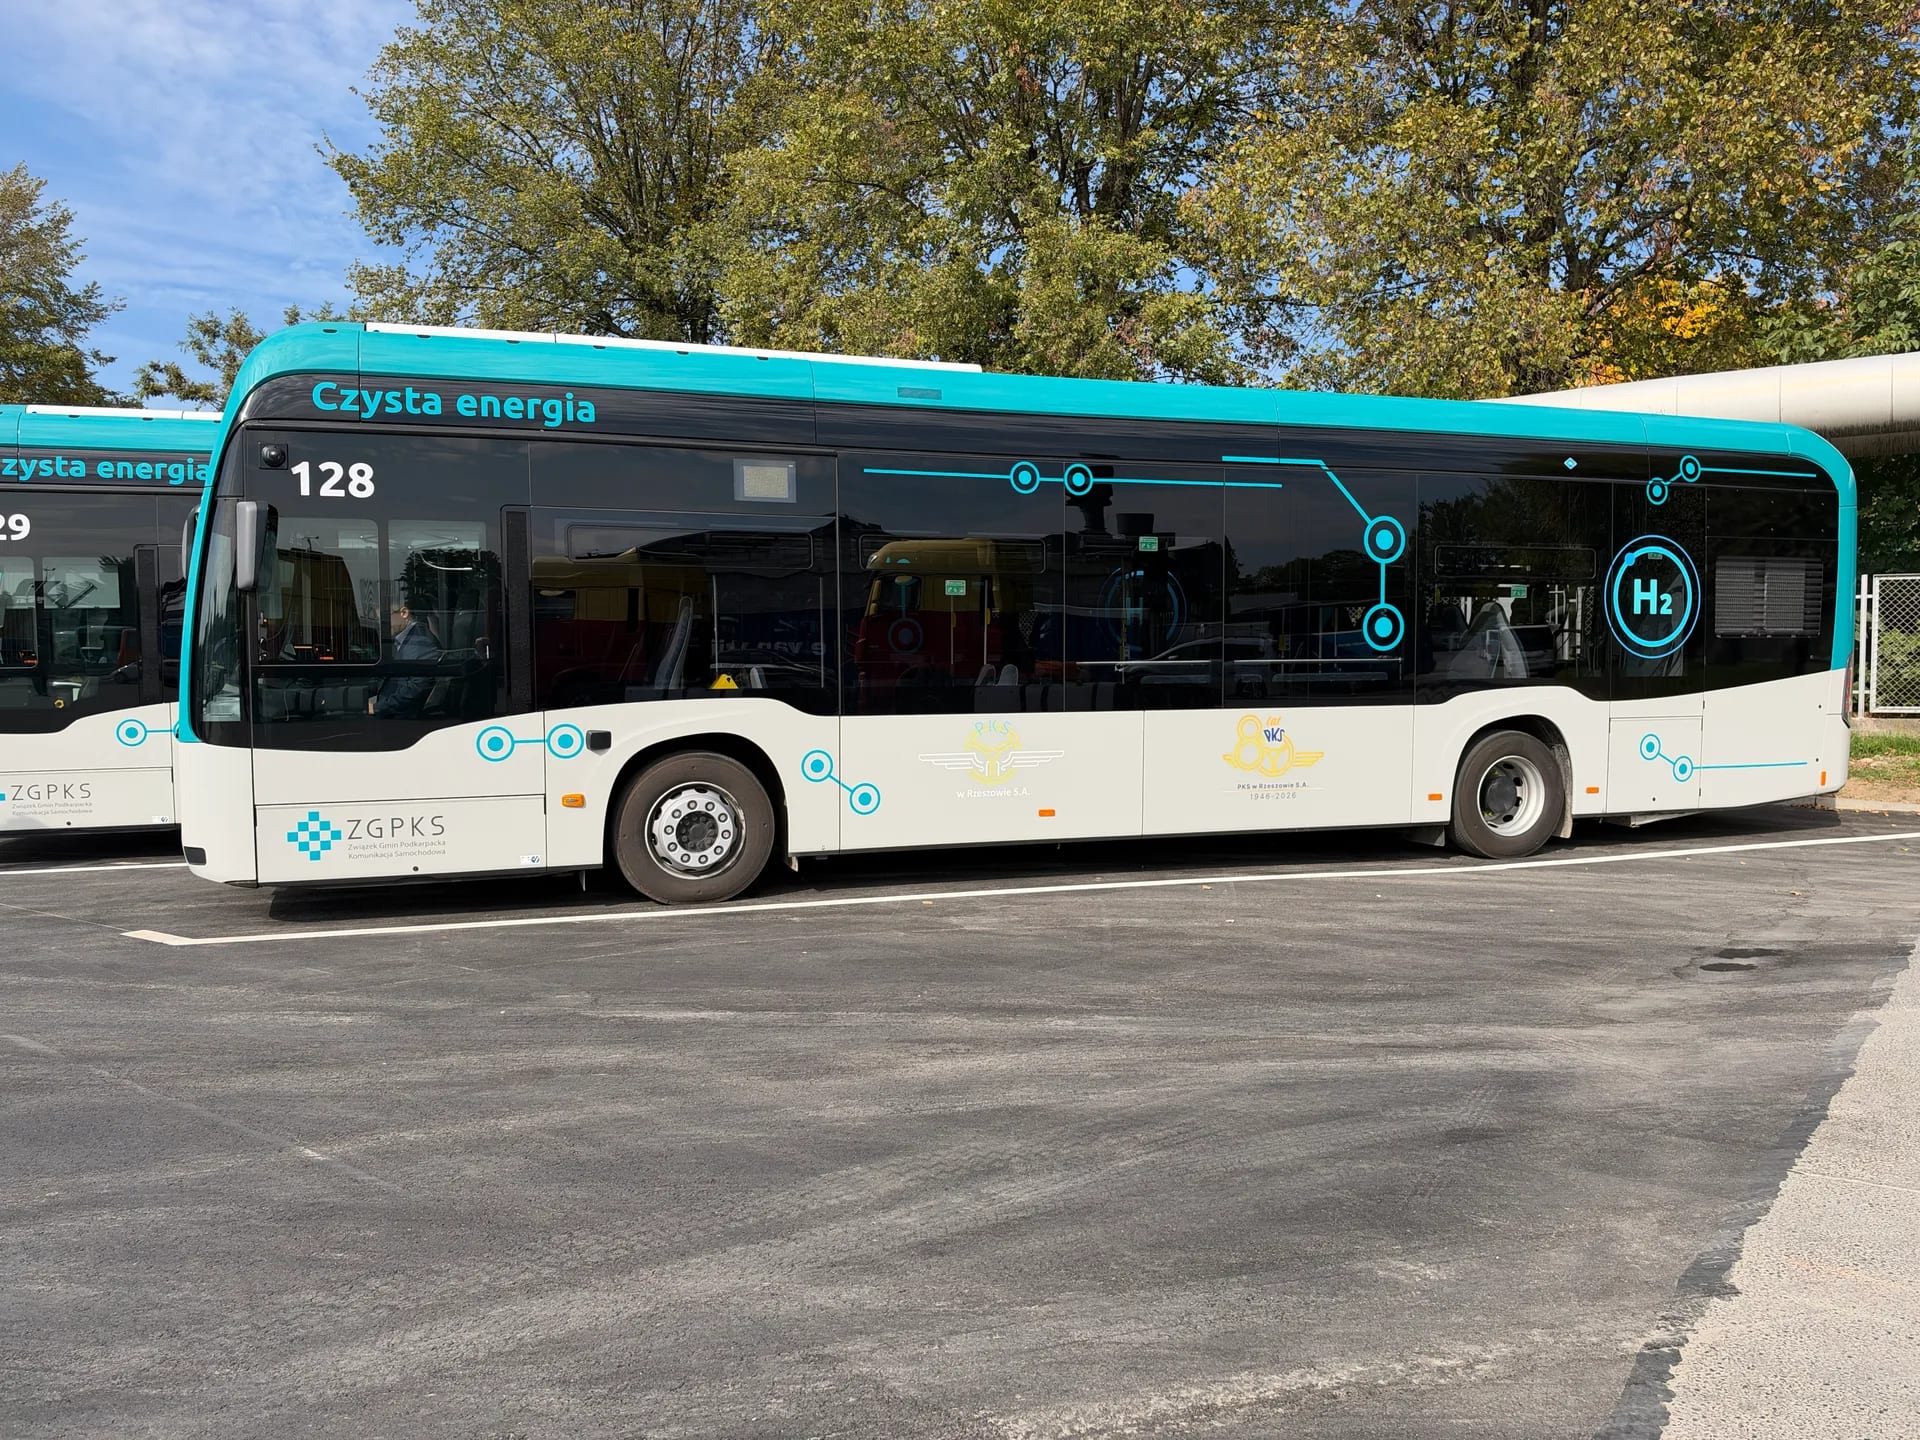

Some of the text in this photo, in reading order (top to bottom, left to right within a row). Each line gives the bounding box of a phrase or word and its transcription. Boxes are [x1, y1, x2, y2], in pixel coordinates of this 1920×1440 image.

[311, 381, 596, 427] Czysta energia
[96, 457, 210, 485] energia
[290, 461, 375, 499] 128
[1633, 578, 1673, 615] H2
[1263, 727, 1285, 742] PKS
[10, 783, 92, 801] ZGPKS
[346, 815, 445, 840] ZGPKS
[348, 848, 446, 860] Komunikacja Samochodowa
[379, 841, 399, 850] Gmin
[400, 839, 446, 849] Podkarpacka
